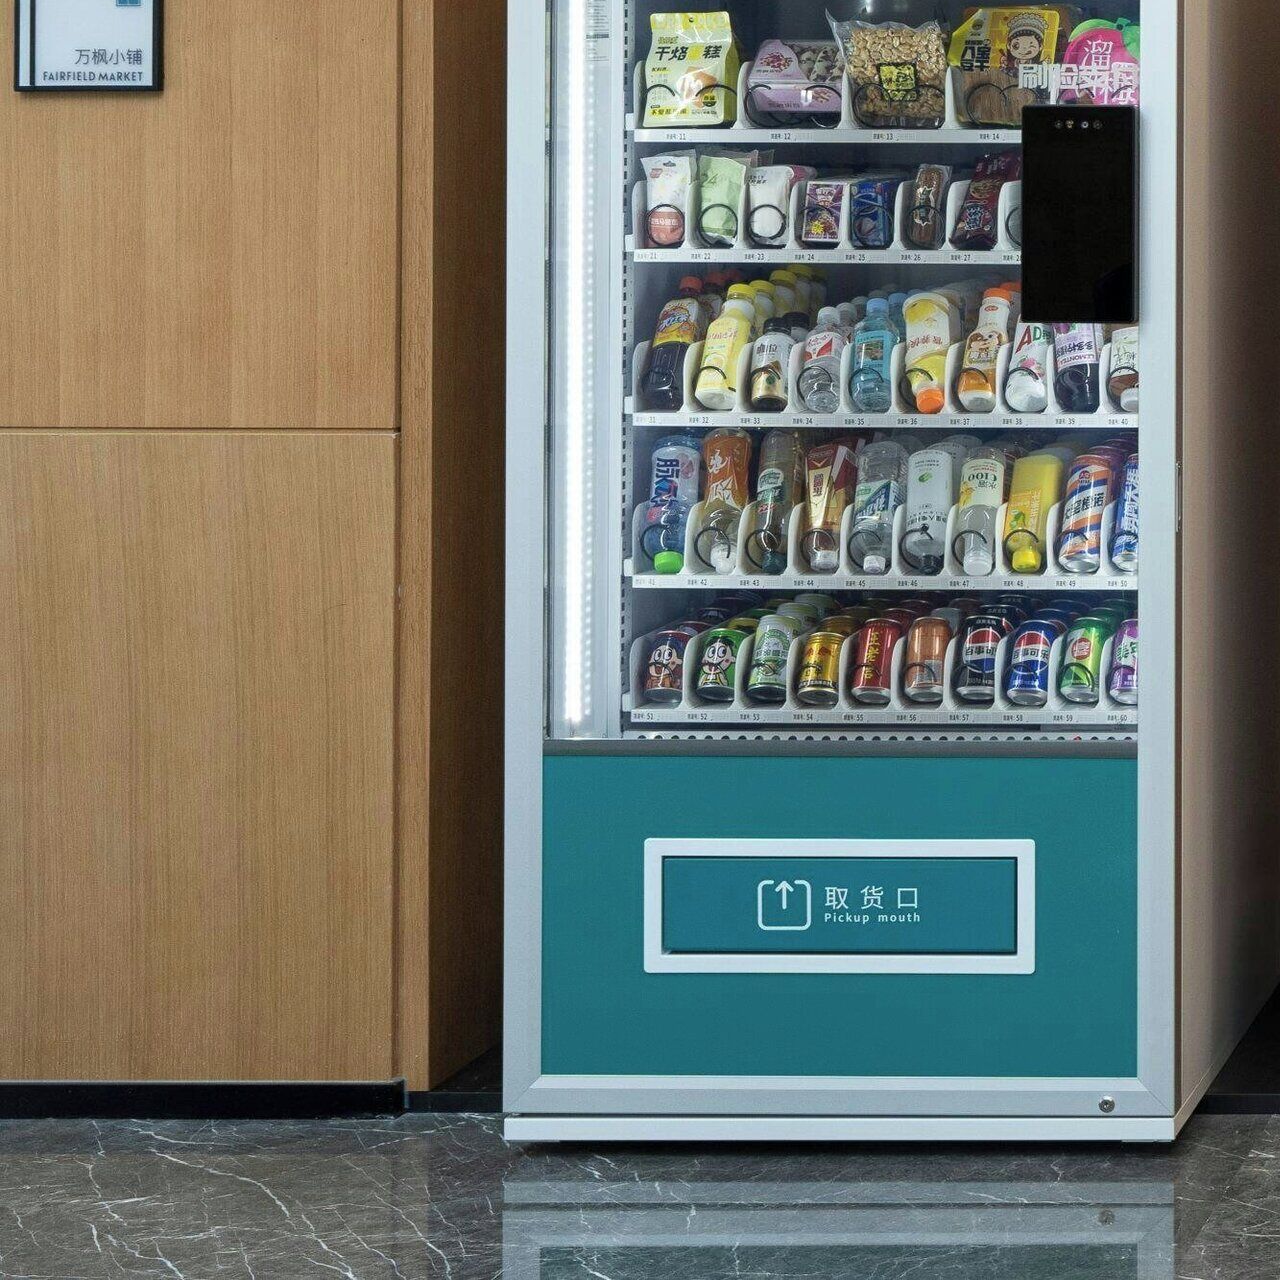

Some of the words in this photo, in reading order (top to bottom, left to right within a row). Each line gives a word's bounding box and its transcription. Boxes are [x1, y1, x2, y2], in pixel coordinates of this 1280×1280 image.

[75, 48, 142, 66] 万枫小铺
[654, 44, 722, 60] 干烙糕
[43, 72, 96, 82] FAIRFIELD
[98, 72, 142, 82] MARKET
[864, 632, 880, 680] 王老吉
[966, 647, 996, 656] 百事可
[1013, 646, 1050, 659] 百事可乐
[824, 886, 918, 910] 取货口
[824, 912, 870, 924] Pickup
[878, 912, 920, 922] mouth
